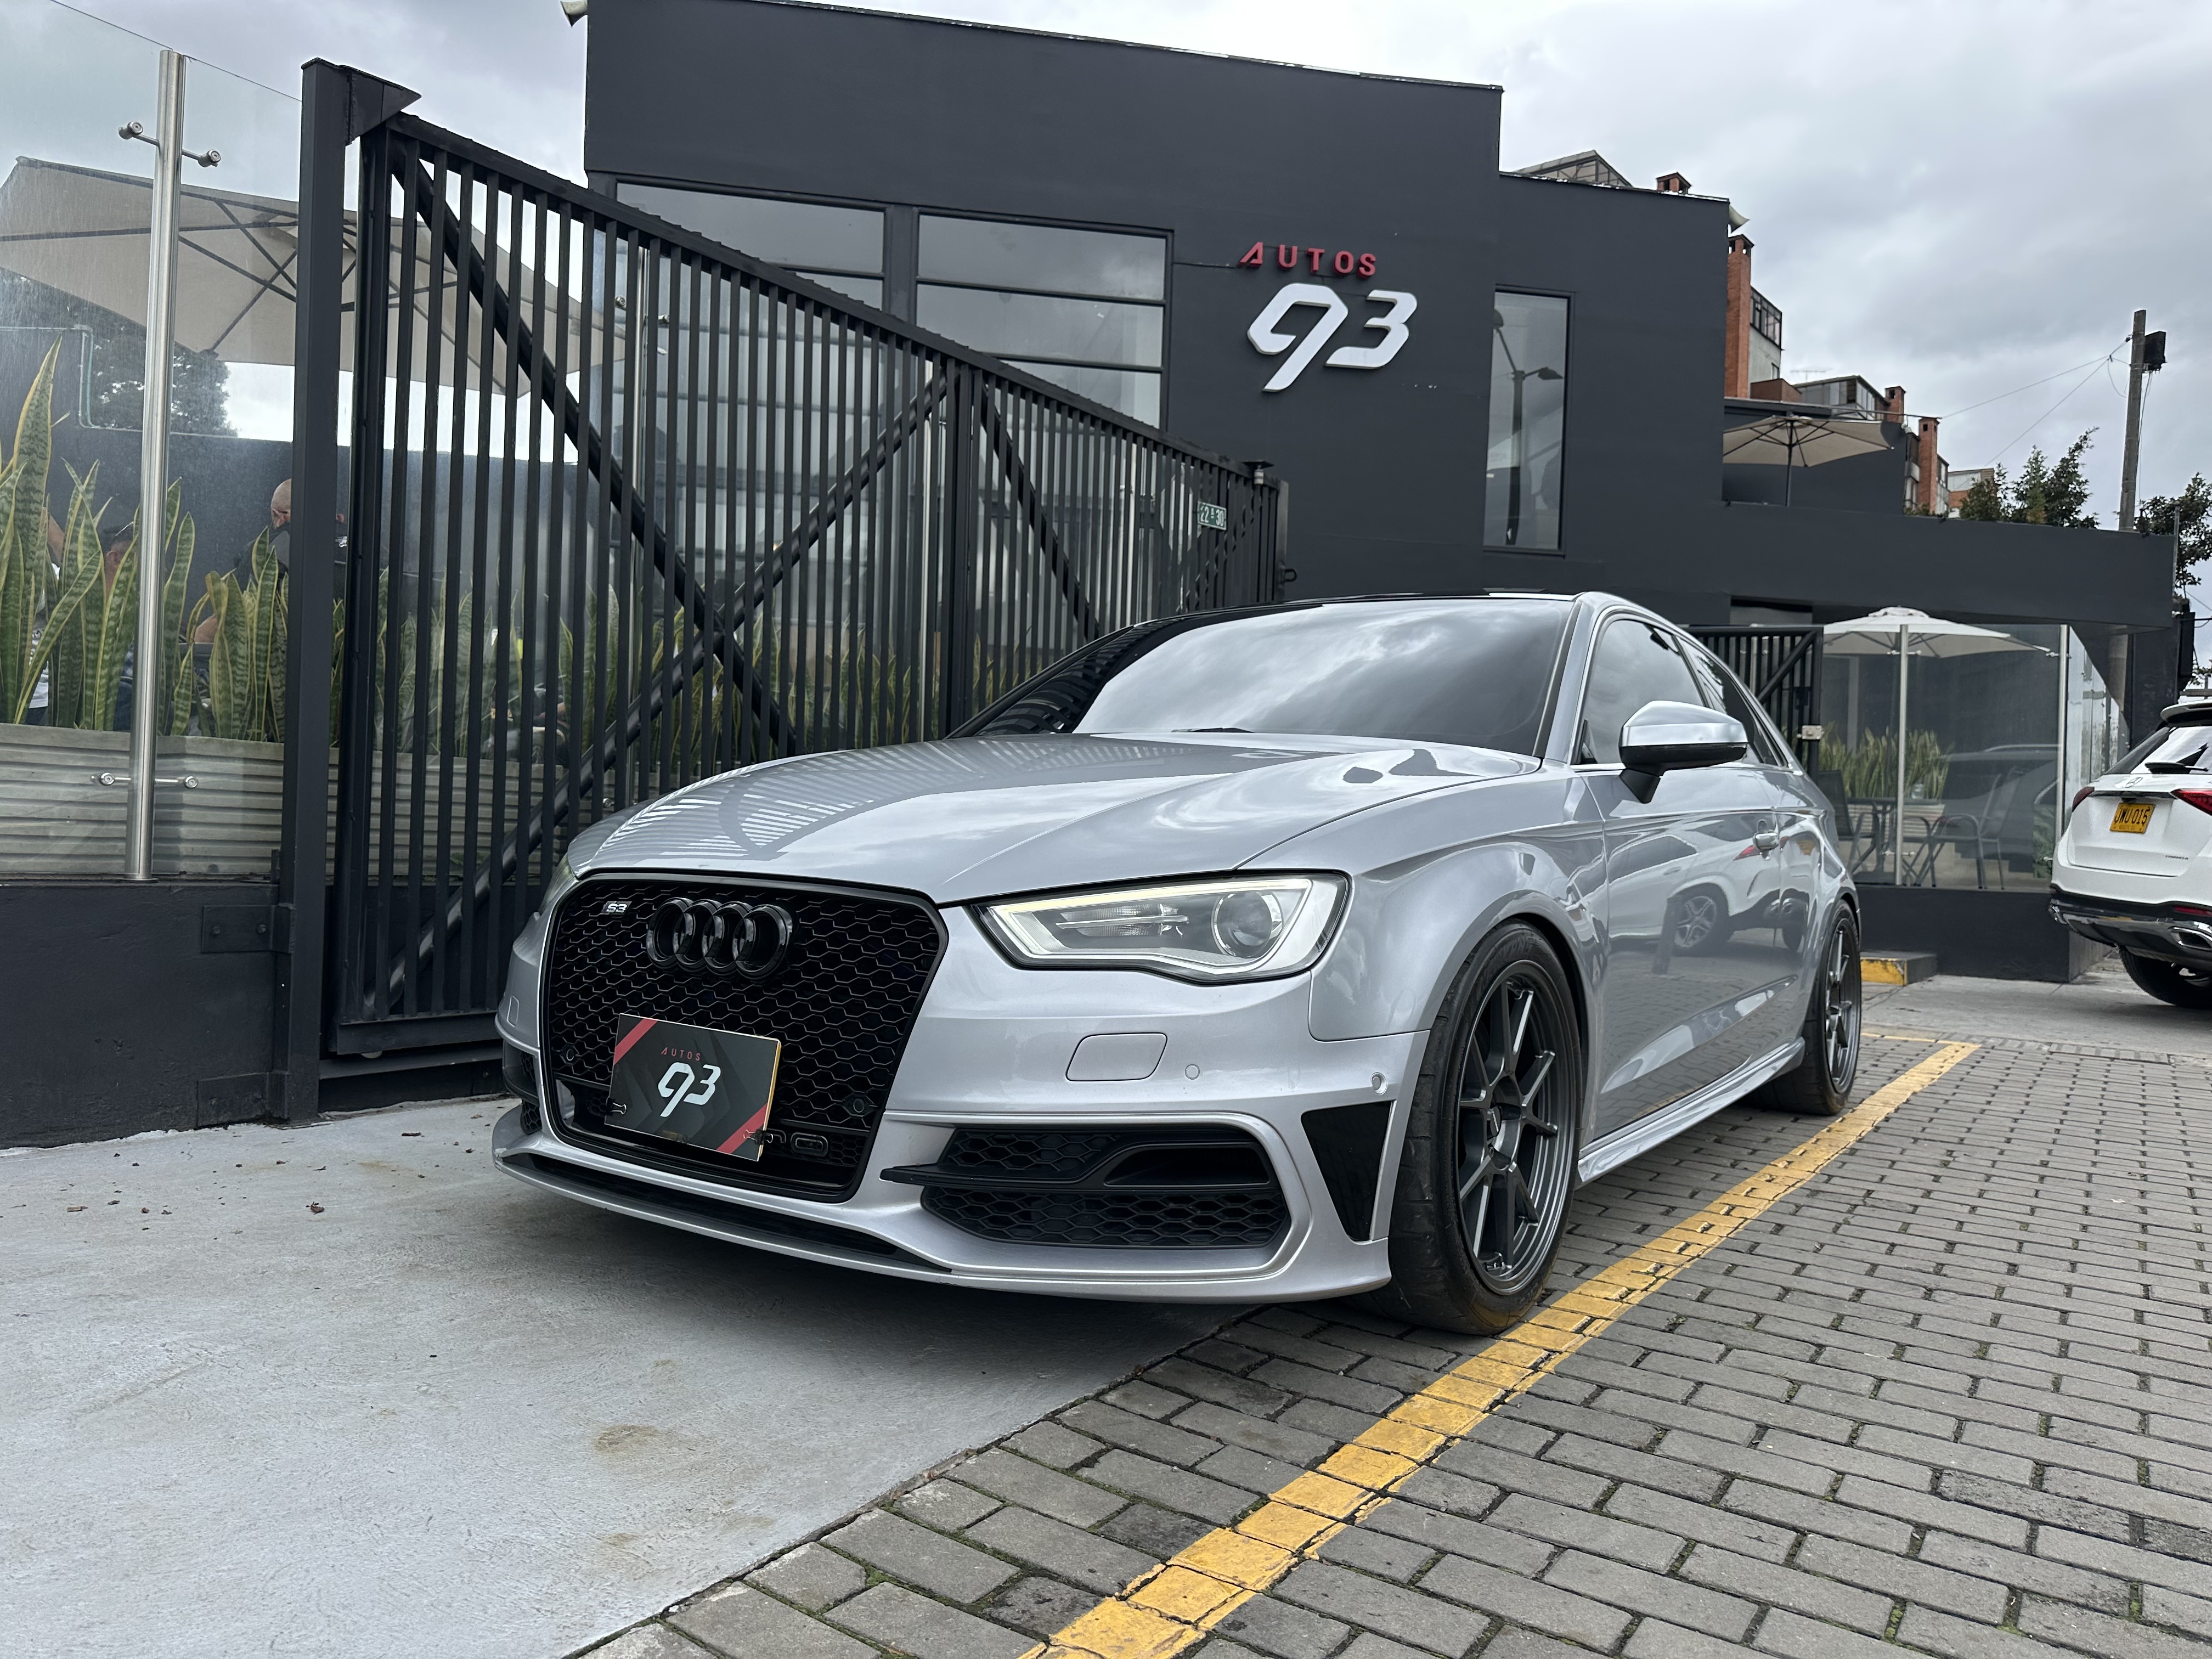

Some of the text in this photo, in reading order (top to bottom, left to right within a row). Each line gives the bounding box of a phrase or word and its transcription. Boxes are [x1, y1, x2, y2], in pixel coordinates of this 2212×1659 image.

[1239, 241, 1377, 278] AUTOS
[1246, 281, 1418, 392] 93
[2114, 807, 2151, 825] JWU 015
[606, 903, 628, 913] S3
[660, 1046, 702, 1062] AUTOS
[657, 1061, 721, 1118] 93
